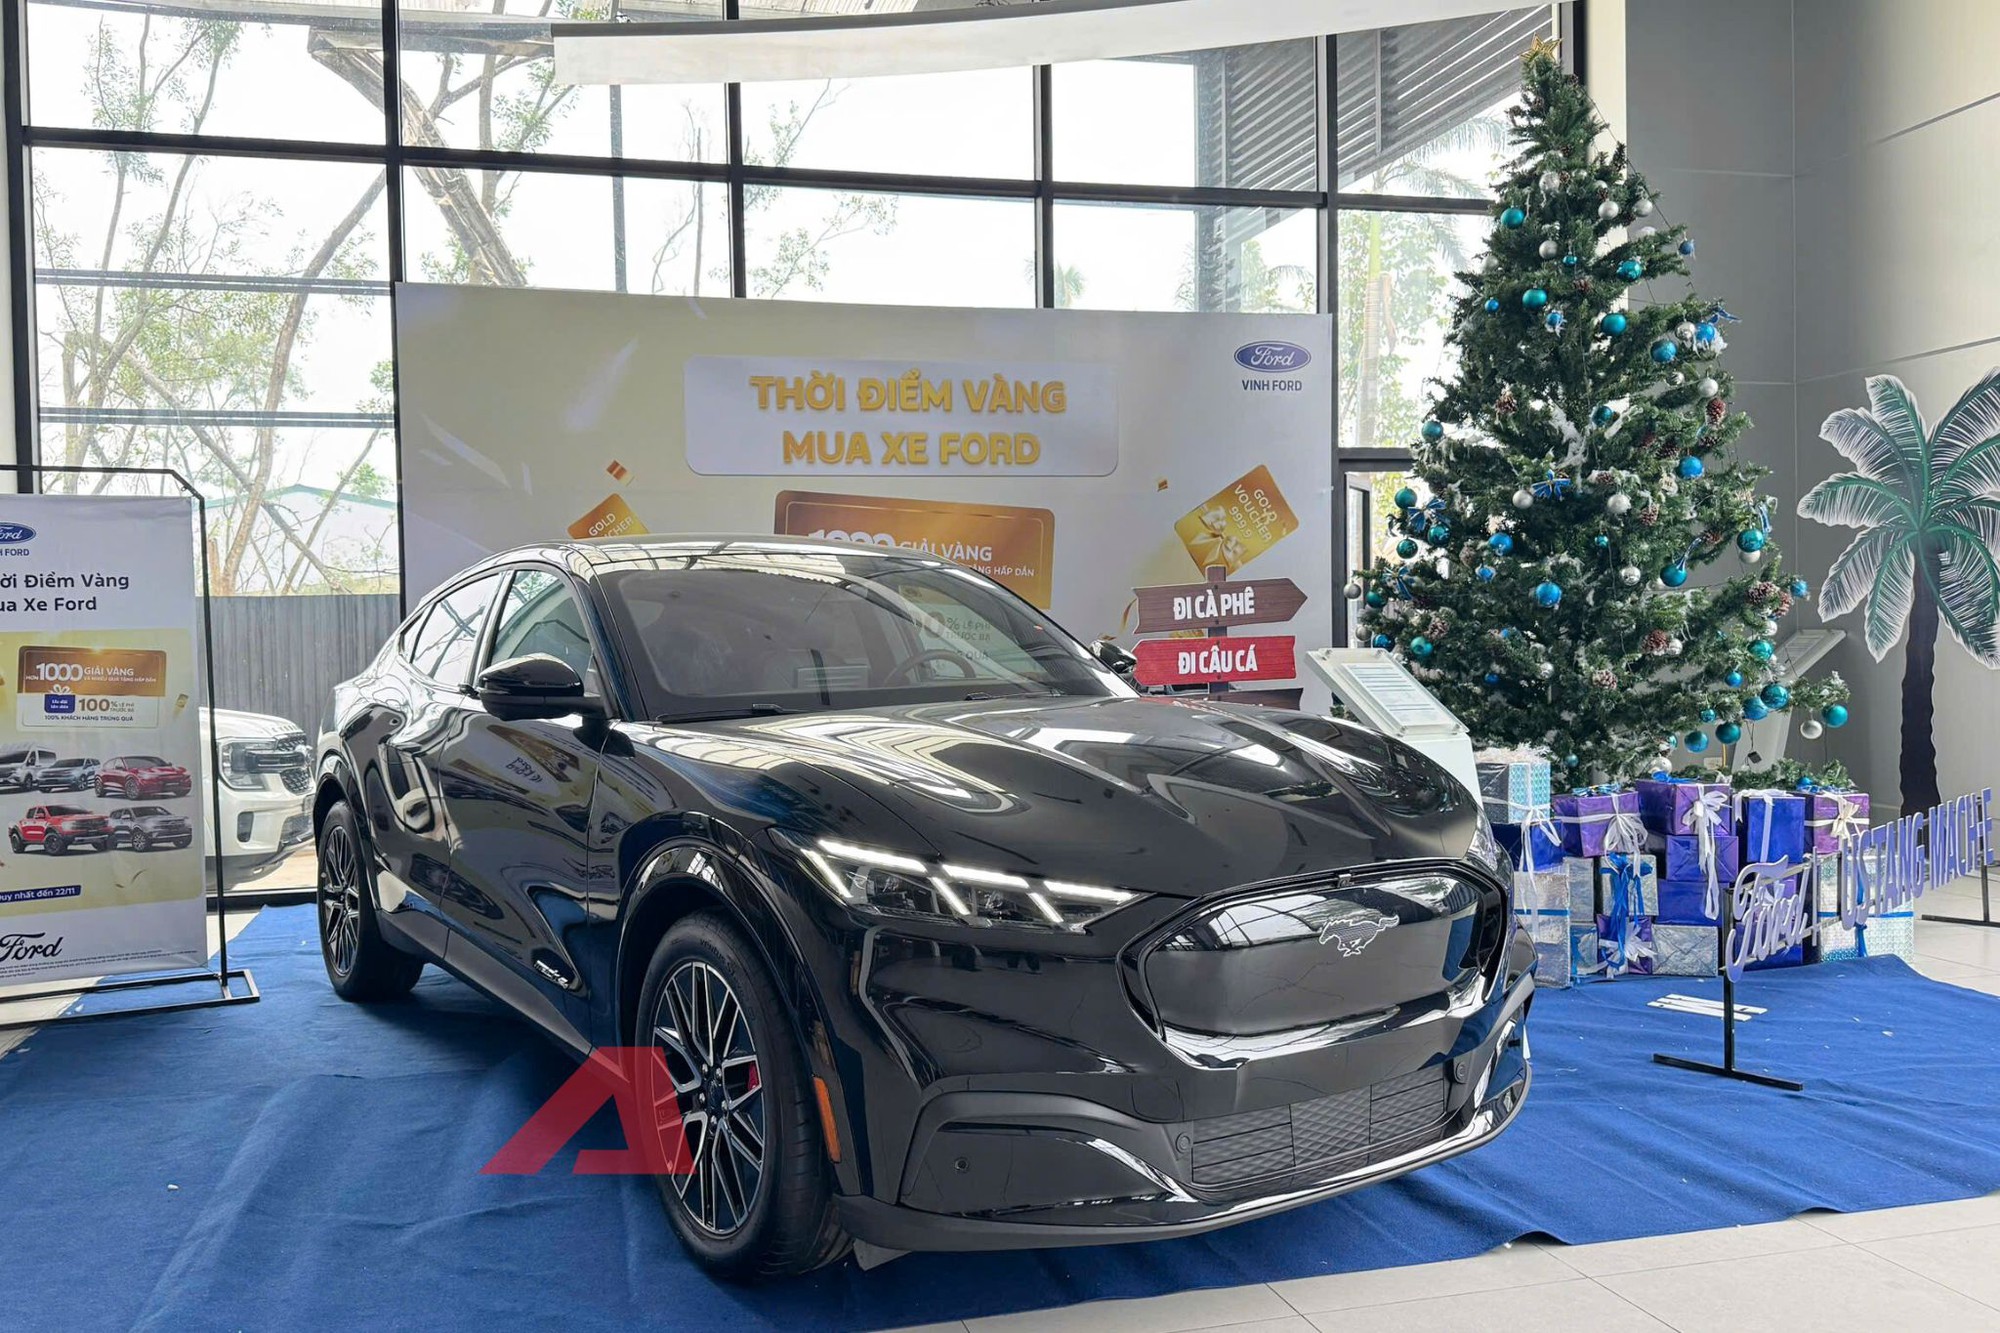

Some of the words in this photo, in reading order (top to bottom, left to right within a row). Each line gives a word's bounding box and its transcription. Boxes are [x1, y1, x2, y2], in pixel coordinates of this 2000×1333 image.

[1250, 345, 1296, 367] Ford
[750, 370, 846, 411] THỜI
[856, 368, 952, 412] ĐIỂM
[962, 373, 1067, 414] VÀNG
[1241, 379, 1270, 391] VINH
[1272, 380, 1302, 391] FORD
[783, 431, 872, 464] MUA
[881, 432, 929, 465] XE
[939, 433, 1041, 465] FORD
[1234, 484, 1272, 541] VOUCHER
[0, 526, 23, 540] ord
[588, 513, 616, 537] GOLD
[5, 548, 30, 557] FORD
[939, 544, 993, 562] VÀNG
[81, 572, 130, 590] Vàng
[24, 597, 48, 612] Xe
[54, 596, 97, 611] Ford
[1173, 596, 1192, 620] ĐI
[1194, 589, 1219, 619] CÀ
[1220, 586, 1255, 617] PHÊ
[1178, 651, 1196, 675] ĐI
[1198, 644, 1233, 674] CÂU
[1235, 643, 1258, 672] CÁ
[36, 663, 84, 681] 1000
[56, 887, 76, 896] 22/11
[1726, 853, 1812, 983] Ford
[0, 931, 64, 963] Ford
